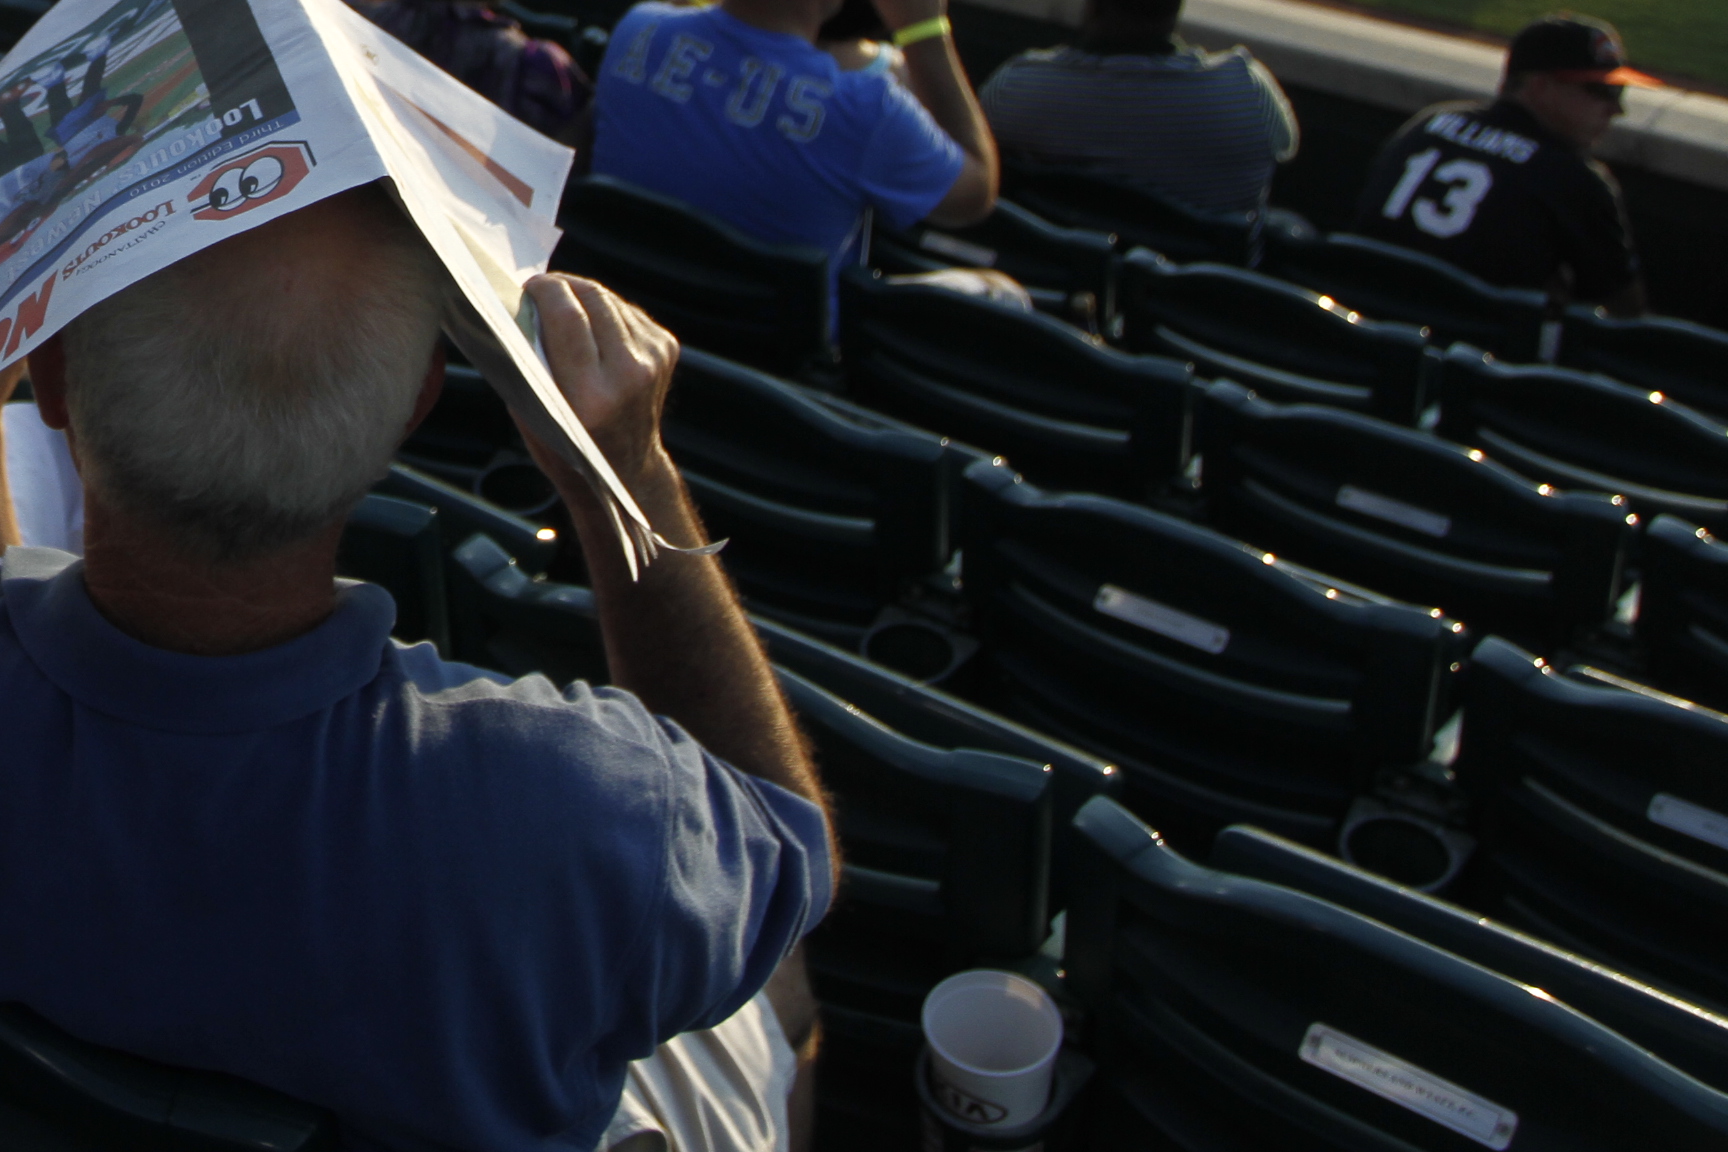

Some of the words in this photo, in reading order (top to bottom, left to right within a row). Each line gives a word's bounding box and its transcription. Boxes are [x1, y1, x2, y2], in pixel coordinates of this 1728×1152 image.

[176, 141, 234, 175] Edition
[238, 120, 284, 145] Third
[1424, 112, 1540, 164] WILLIAMS
[129, 173, 171, 198] 2010
[1381, 146, 1494, 239] 13
[62, 199, 176, 281] LOOKOUTS
[76, 220, 166, 276] CHATTANOOGA
